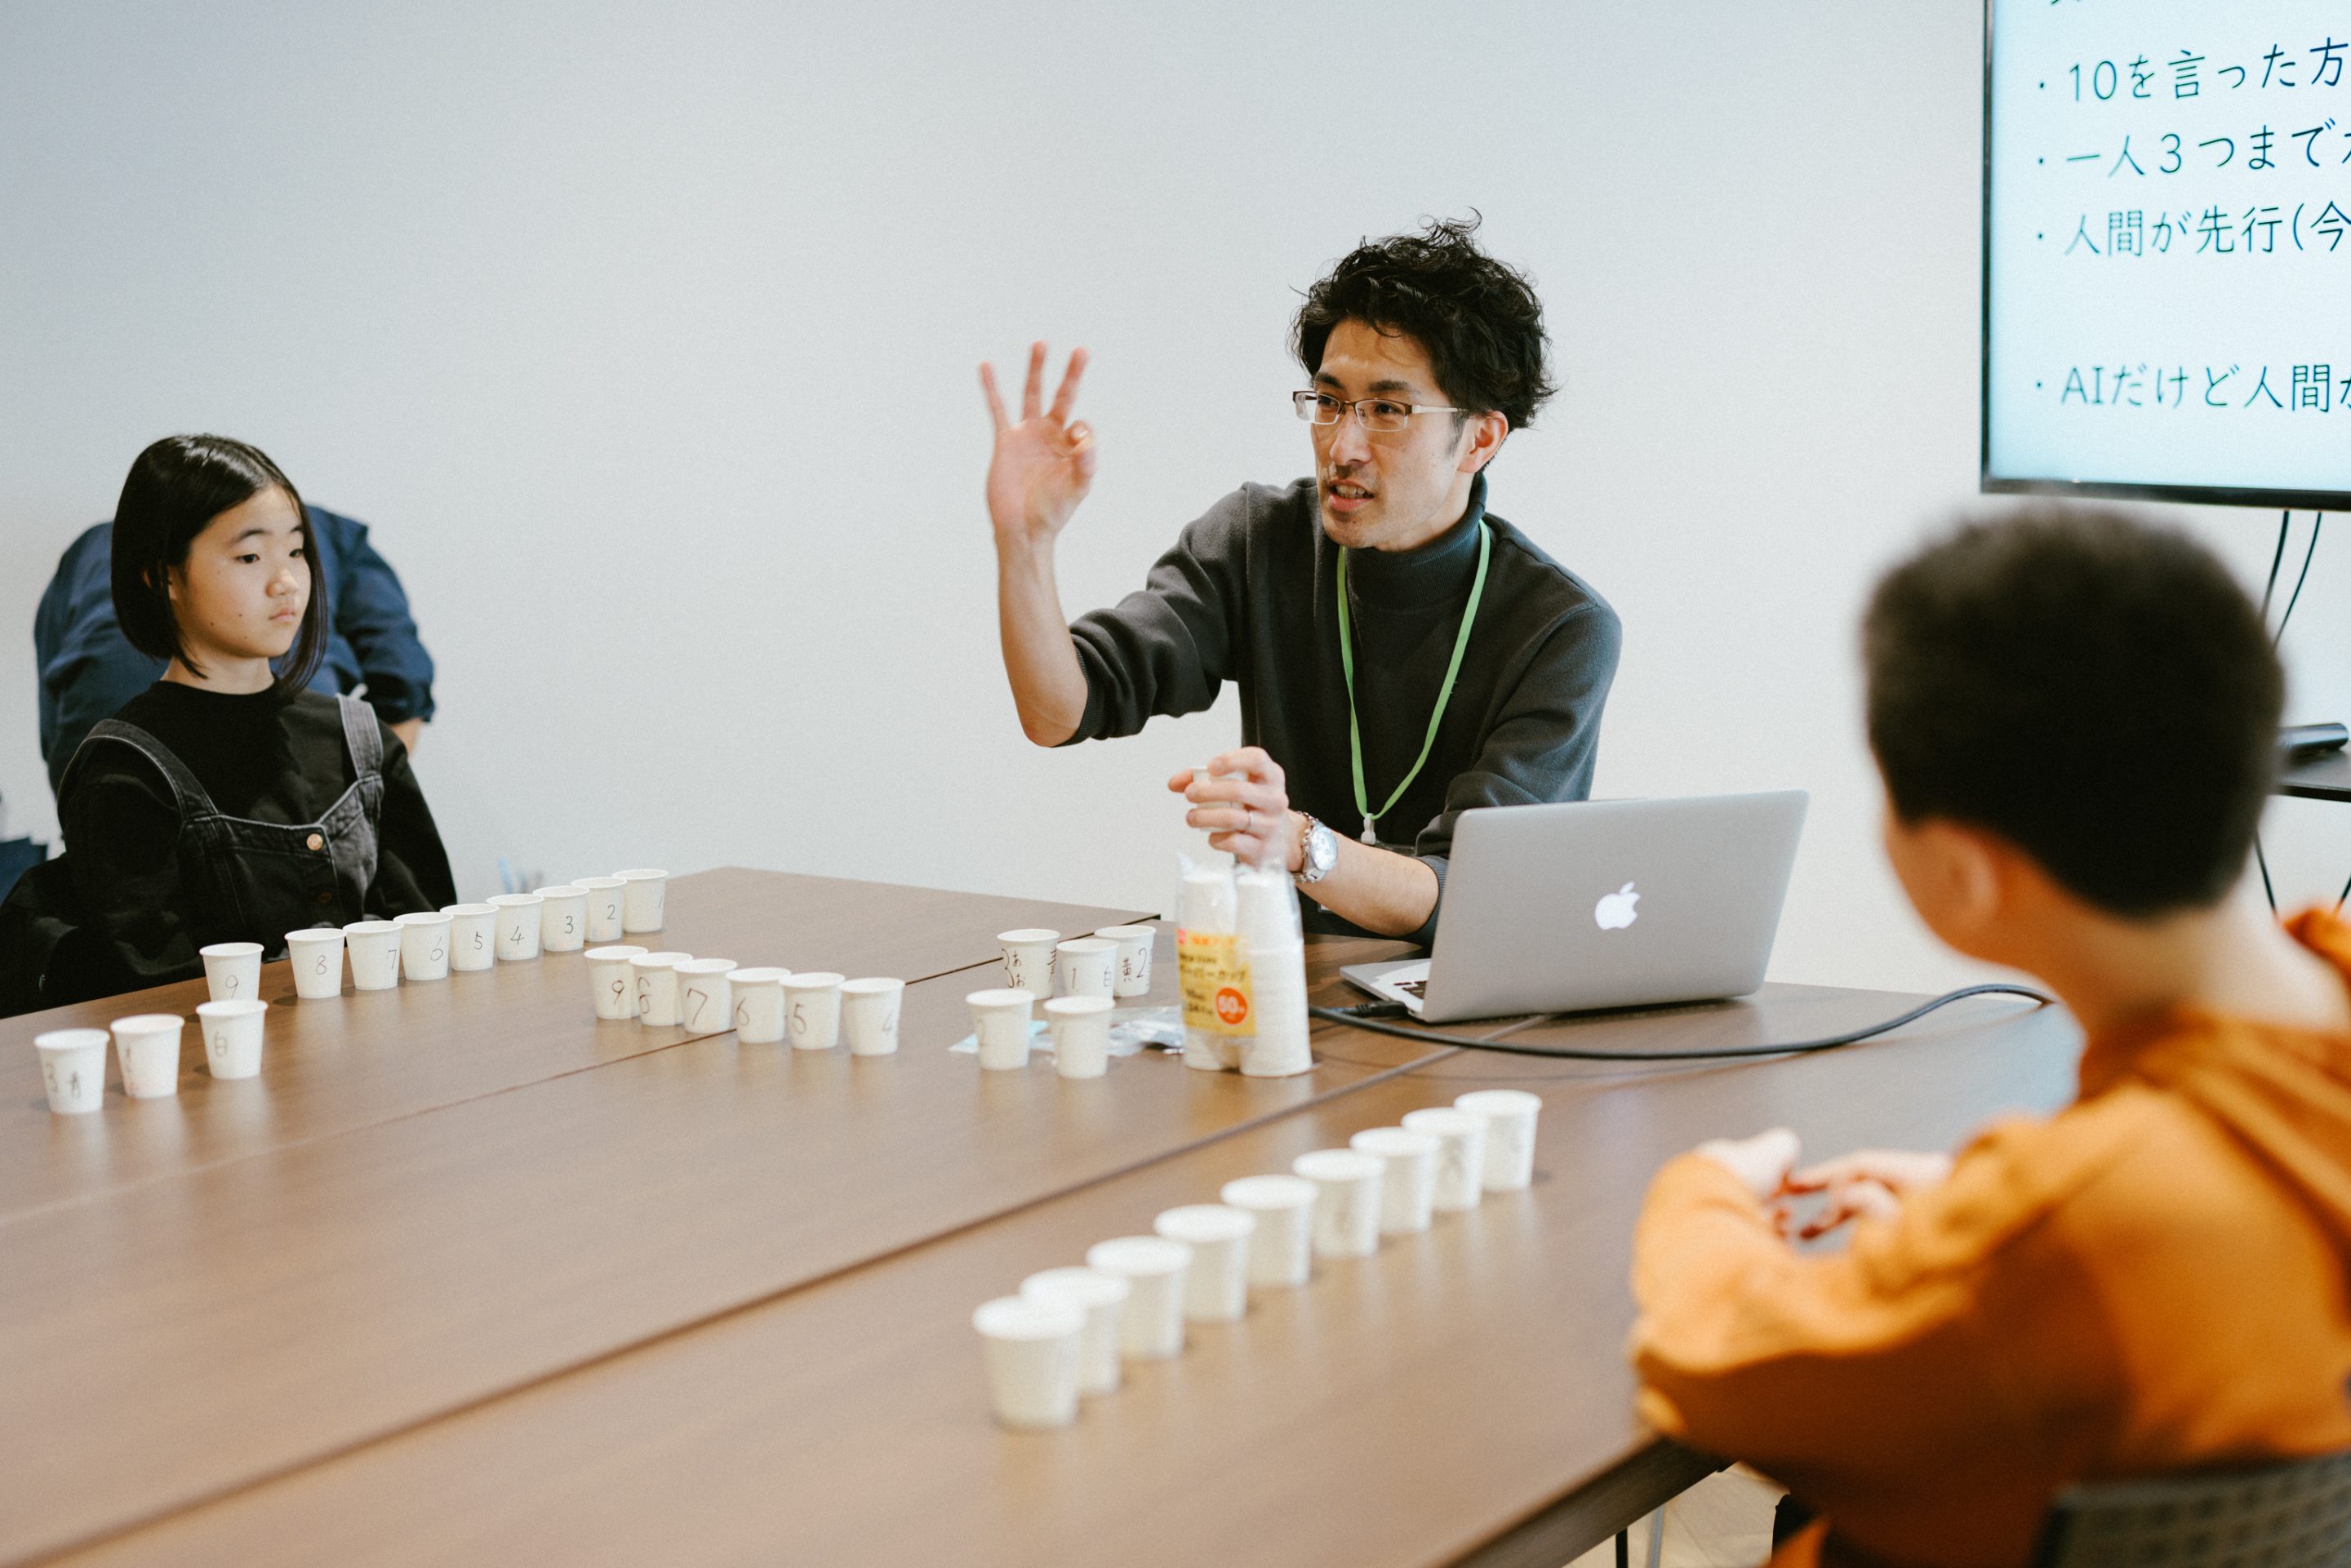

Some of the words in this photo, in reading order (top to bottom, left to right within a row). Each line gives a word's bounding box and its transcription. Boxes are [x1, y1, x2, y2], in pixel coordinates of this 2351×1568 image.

[2066, 118, 2351, 177] 一人3つまで
[607, 904, 616, 920] 2
[509, 926, 525, 945] 4
[564, 915, 575, 935] 3
[429, 936, 443, 962] 6
[473, 932, 483, 951] 5
[315, 954, 327, 976] 8
[387, 949, 398, 971] 7
[1136, 947, 1148, 979] 2
[224, 975, 239, 999] 9
[611, 979, 624, 1006] 9
[687, 988, 708, 1025] 7
[736, 997, 750, 1026] 6
[793, 1003, 807, 1034] 5
